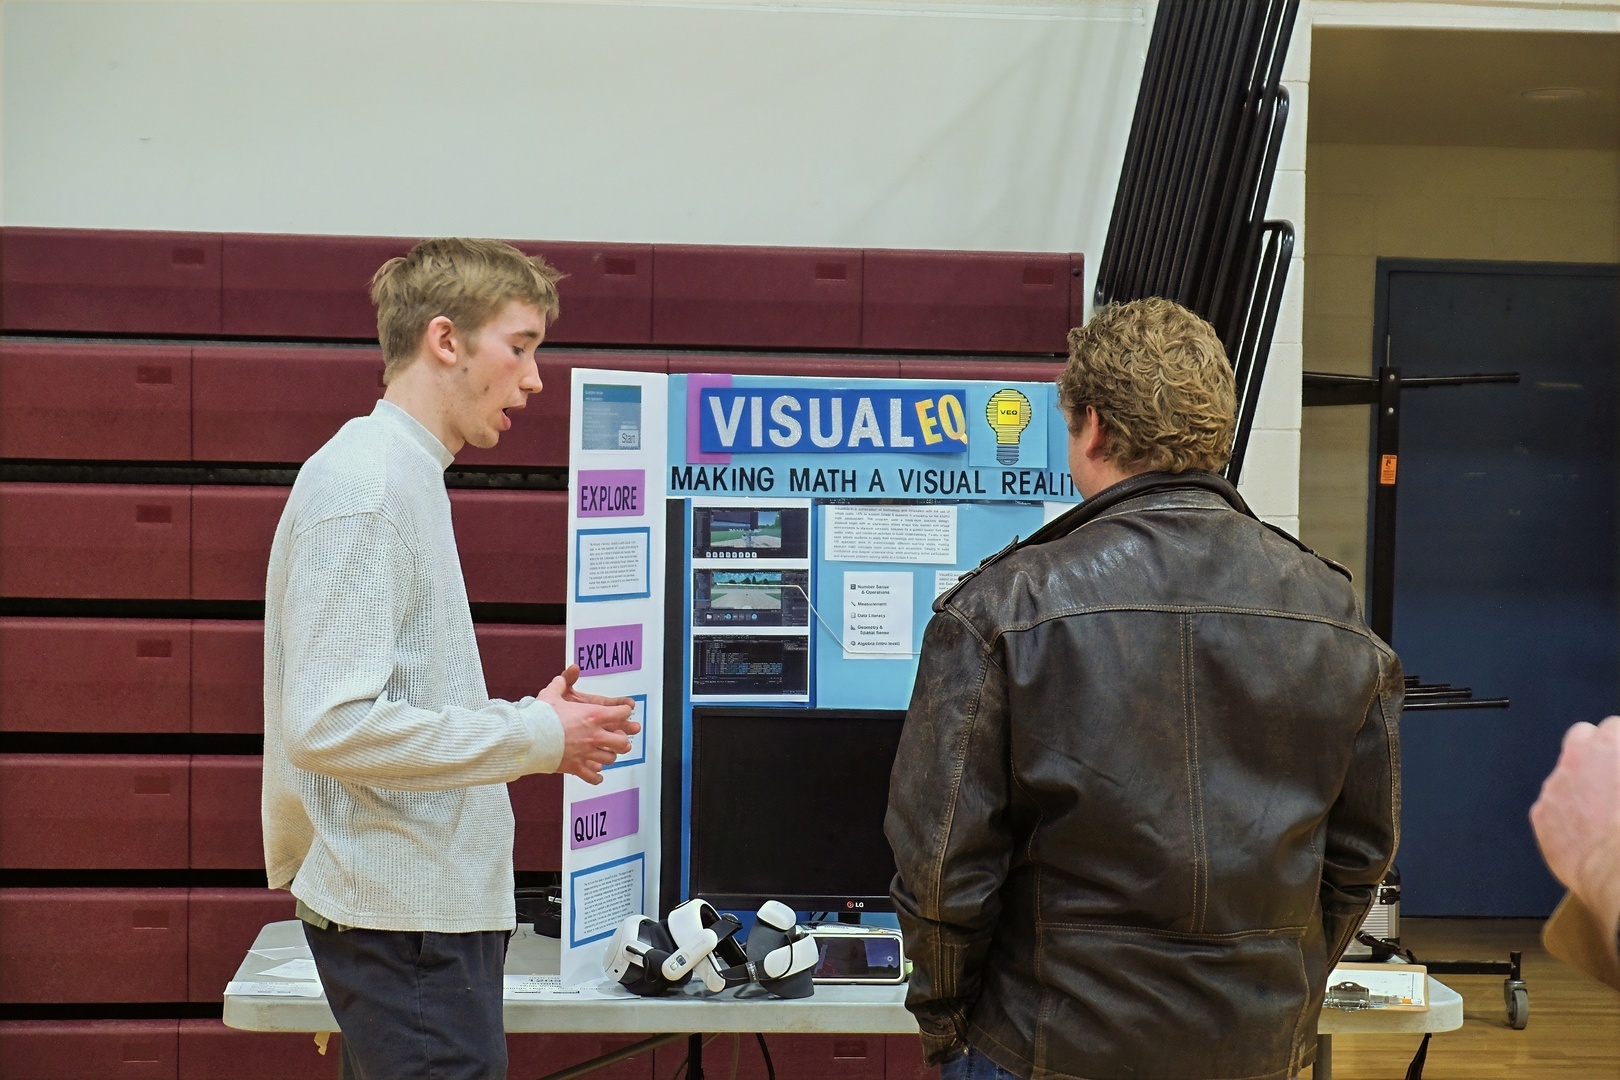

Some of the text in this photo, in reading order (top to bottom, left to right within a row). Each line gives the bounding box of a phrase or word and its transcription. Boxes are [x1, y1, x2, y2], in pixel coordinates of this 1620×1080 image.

[671, 466, 1074, 497] MAKING MATH A VISUAL REALIT
[581, 485, 637, 512] EXPLORE
[578, 640, 634, 671] EXPLAIN
[574, 810, 607, 842] QUIZ
